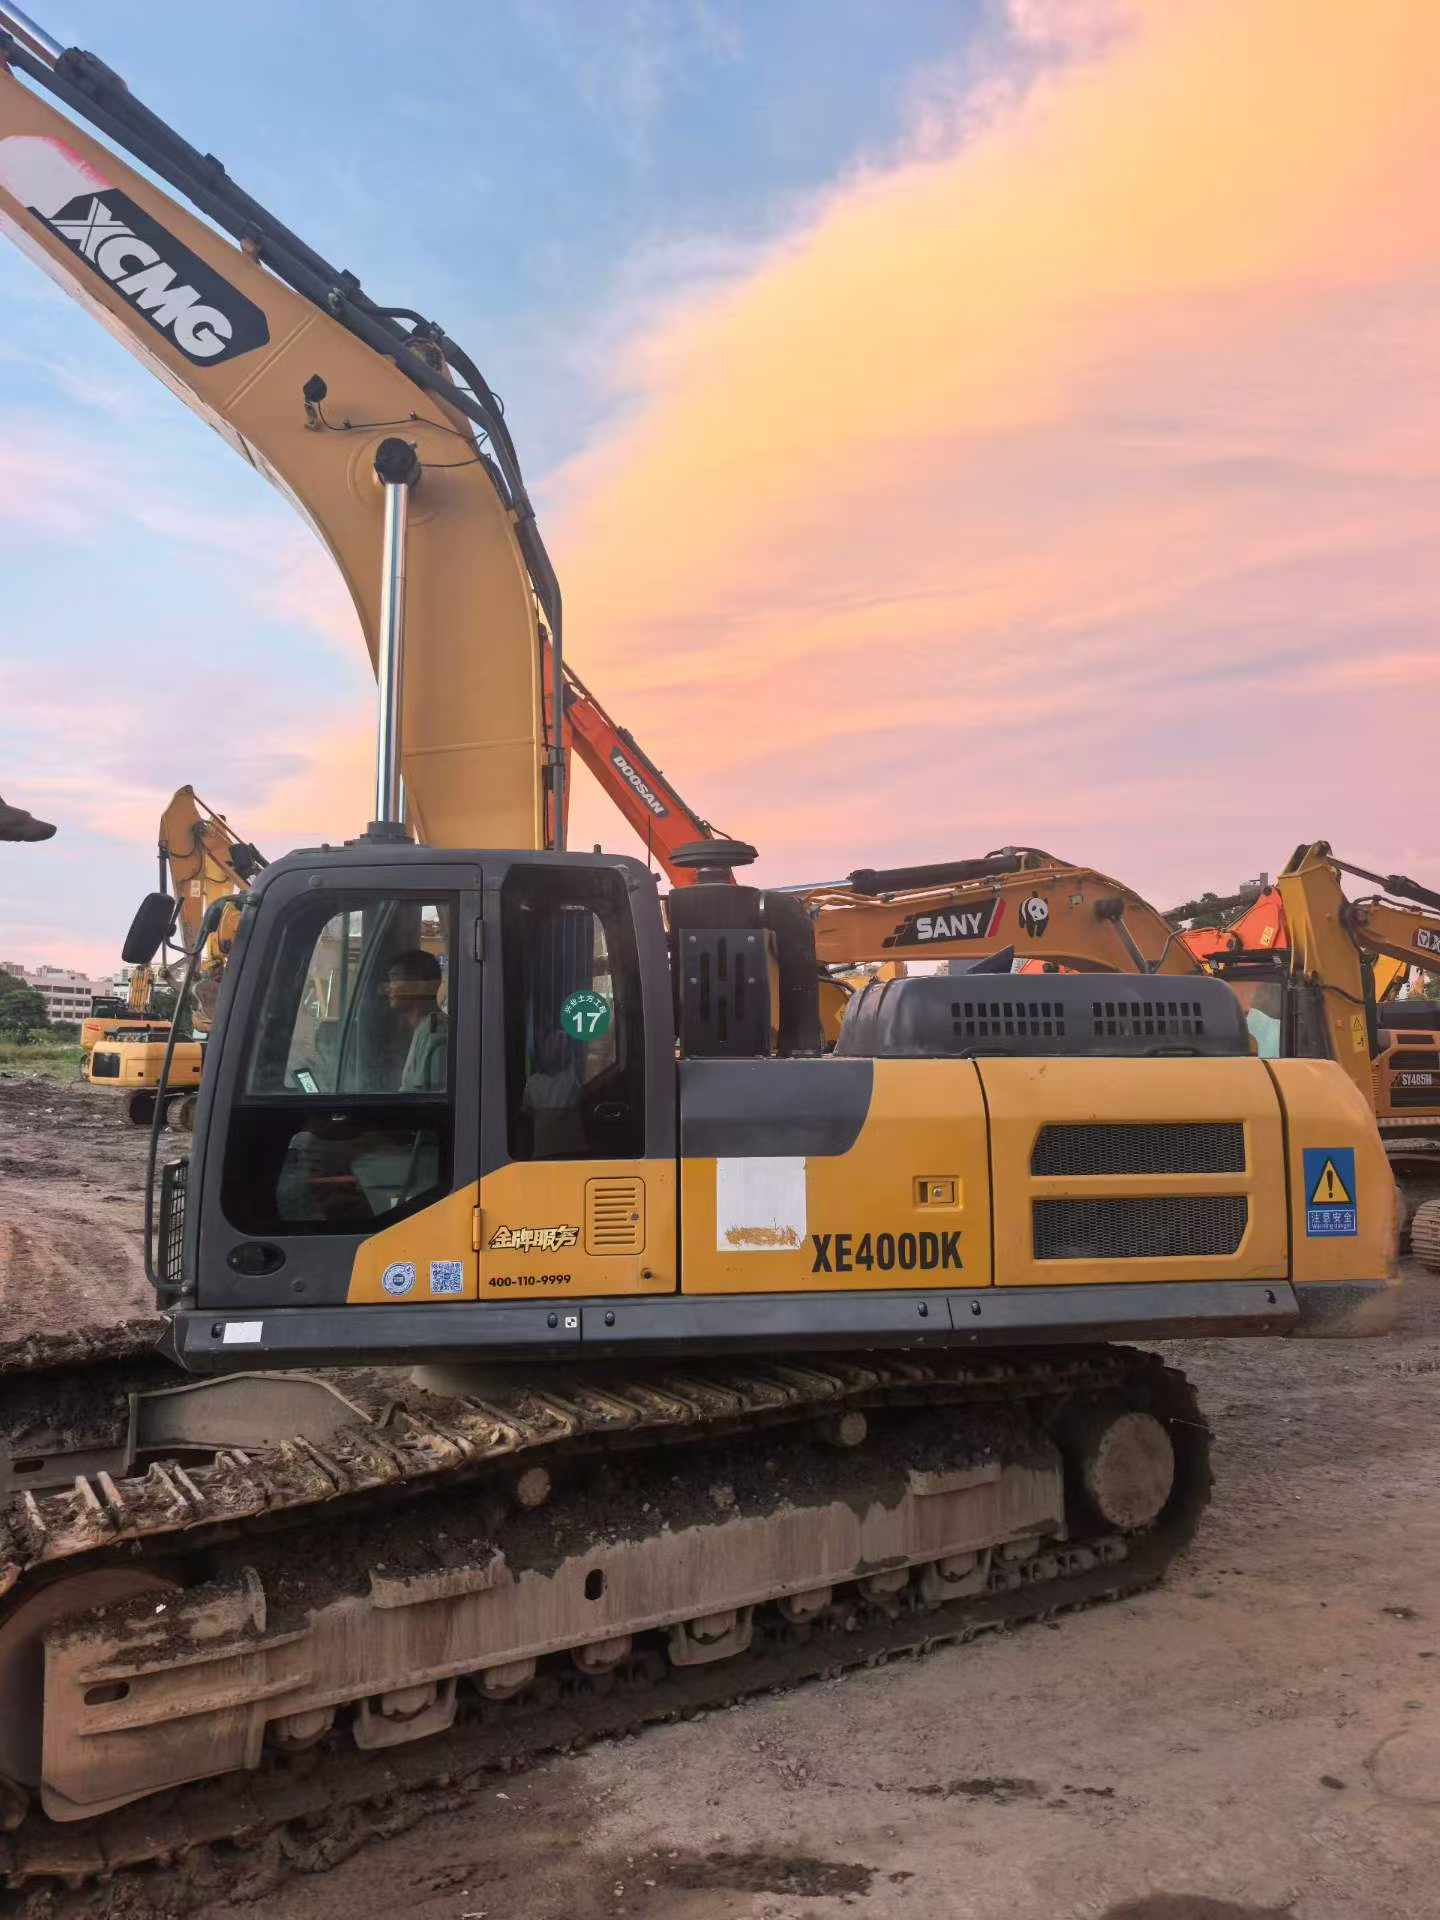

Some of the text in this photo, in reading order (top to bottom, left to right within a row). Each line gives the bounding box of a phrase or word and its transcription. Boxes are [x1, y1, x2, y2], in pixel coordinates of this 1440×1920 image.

[49, 197, 233, 358] XCMG
[916, 912, 982, 940] SANY
[572, 1011, 602, 1033] 17
[1311, 1211, 1352, 1223] 注意安全
[489, 1225, 579, 1252] 金牌服务
[811, 1231, 964, 1273] XE400DK
[488, 1274, 571, 1288] 400-110-9999
